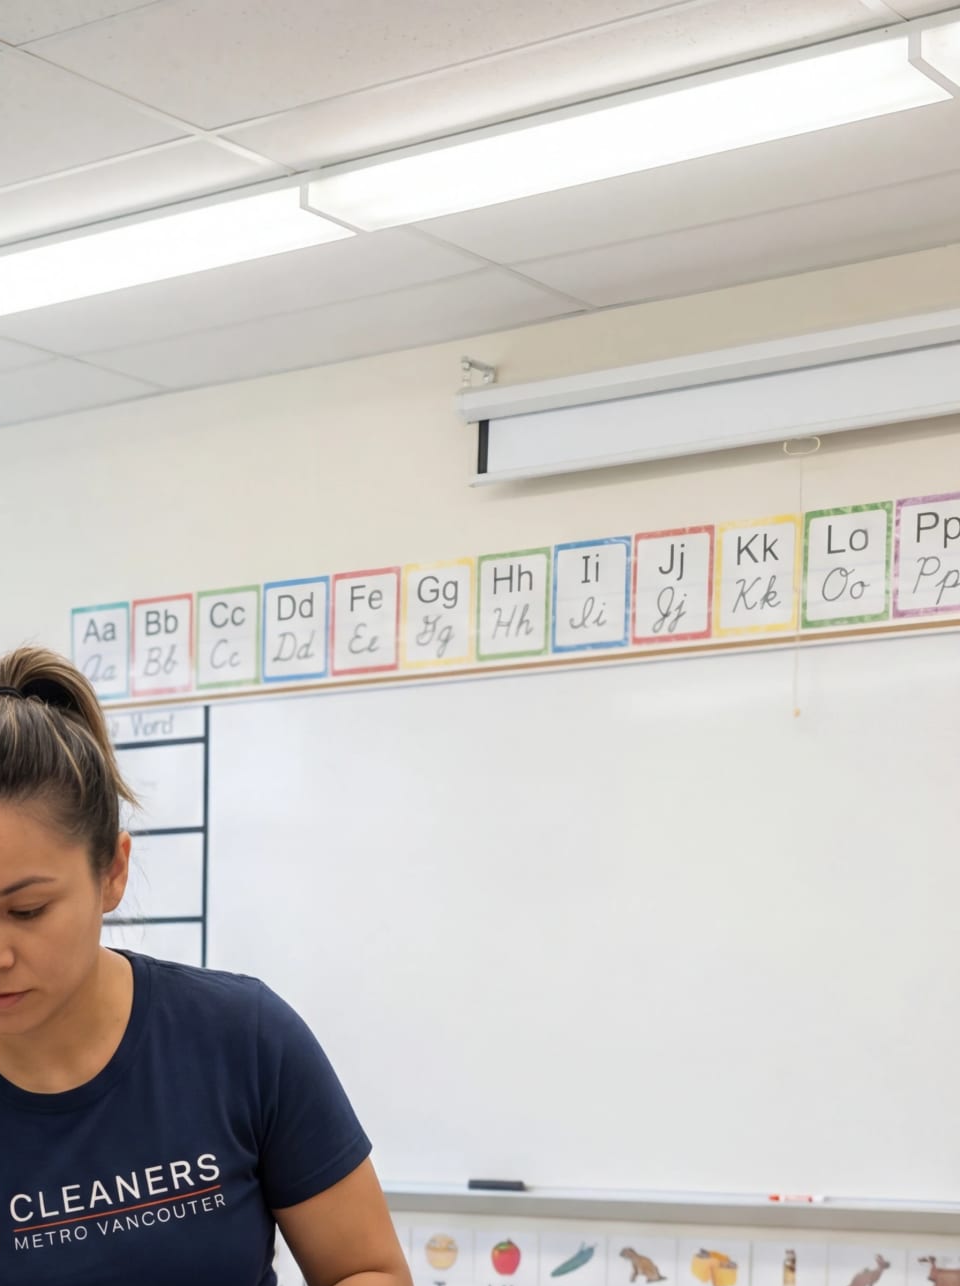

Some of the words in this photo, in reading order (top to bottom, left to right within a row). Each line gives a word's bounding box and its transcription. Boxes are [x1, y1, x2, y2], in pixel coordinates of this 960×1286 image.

[83, 619, 116, 643] Aa
[145, 609, 178, 636] Bb
[210, 602, 245, 628] Cc
[277, 592, 314, 621] Dd
[350, 585, 383, 612] Fe
[417, 576, 458, 609] Gg
[492, 564, 533, 595] Hh
[581, 553, 599, 584] Ii
[658, 544, 685, 581] Jj
[737, 533, 779, 565] Kk
[827, 525, 869, 554] Lo
[916, 512, 960, 549] Pp
[272, 630, 316, 662] Dd
[492, 603, 534, 639] Hh
[732, 574, 781, 613] Kk
[821, 567, 870, 602] Oo
[912, 556, 960, 605] Pp
[10, 1153, 221, 1222] CLEANERS
[14, 1226, 88, 1251] METRO
[96, 1193, 227, 1236] VANCOUTER
